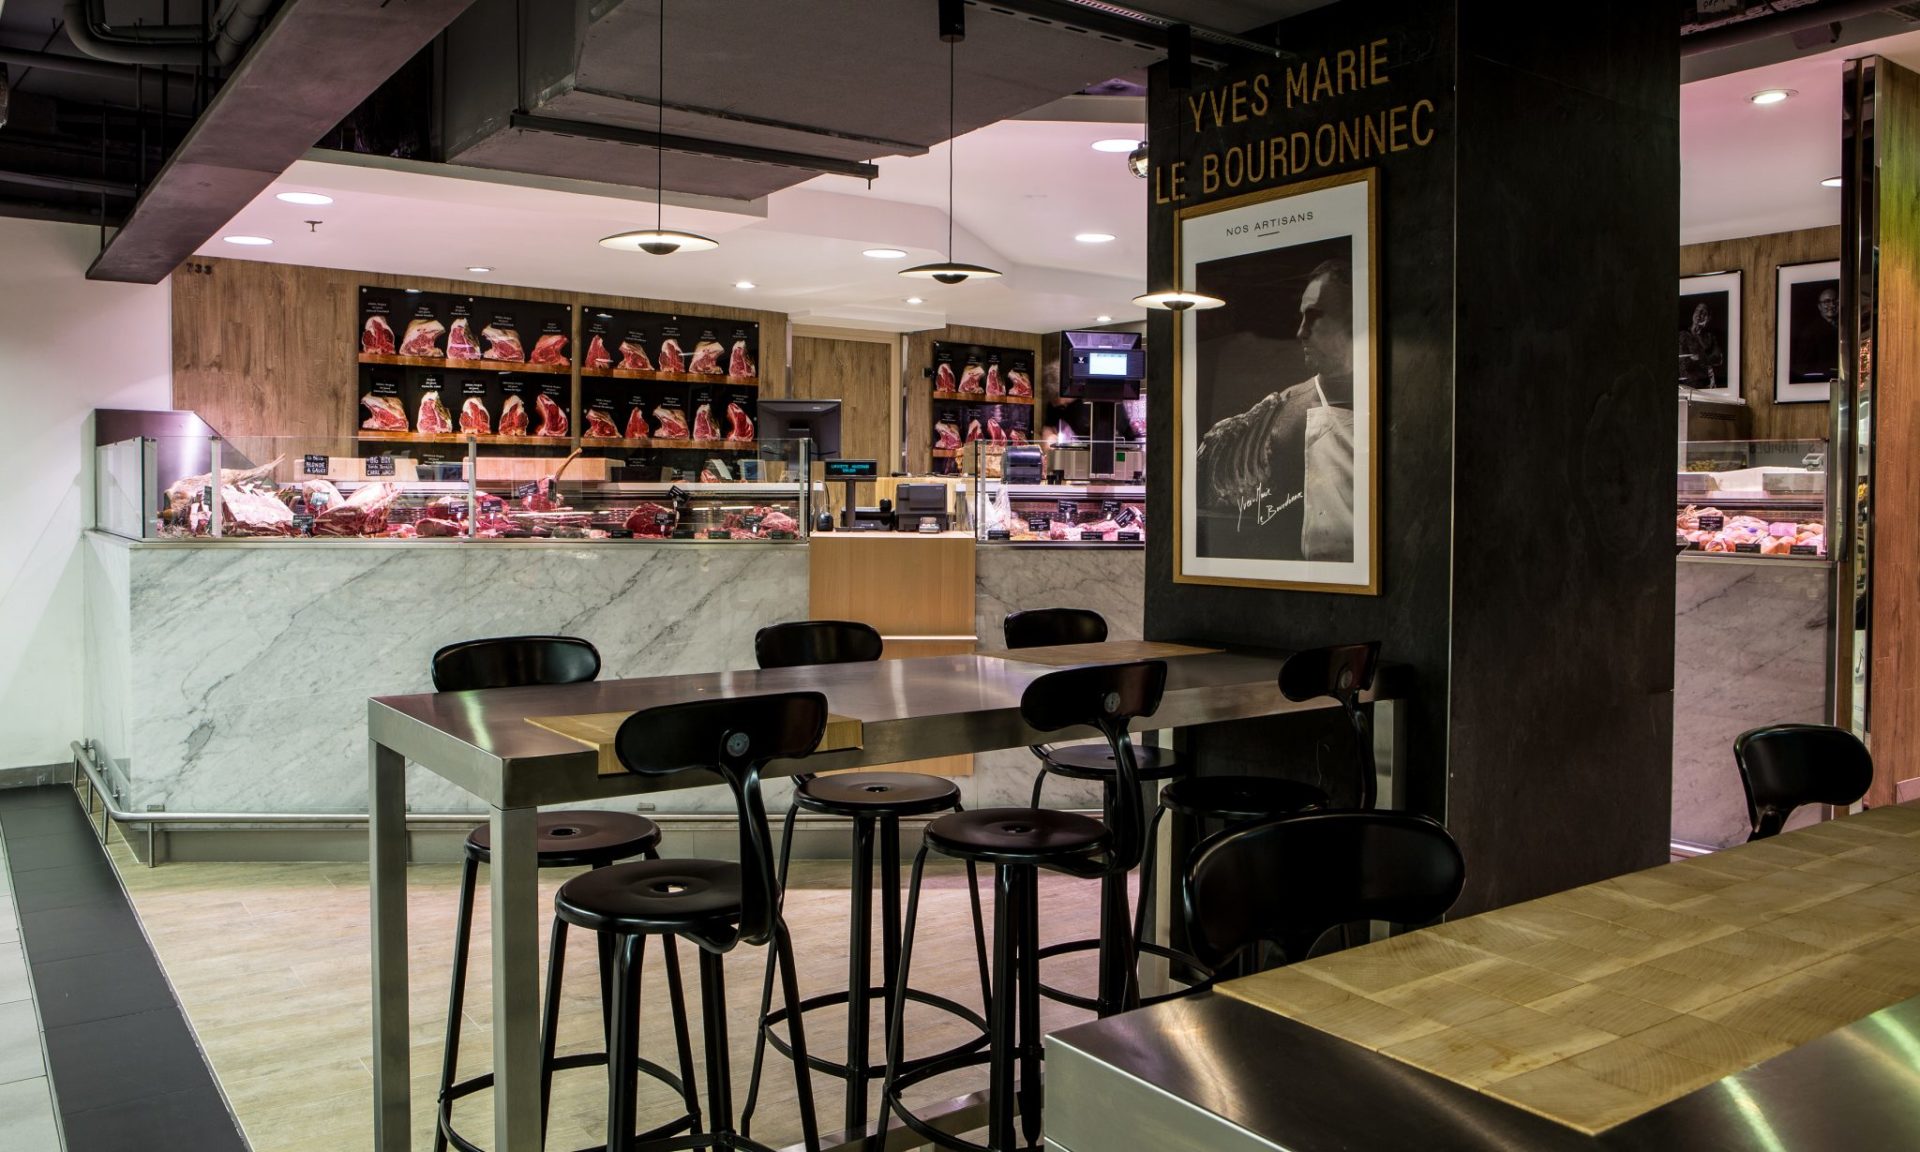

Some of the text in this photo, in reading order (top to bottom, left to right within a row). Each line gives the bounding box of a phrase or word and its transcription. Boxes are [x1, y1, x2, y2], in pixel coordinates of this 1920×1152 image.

[1188, 38, 1389, 133] YVES MARIE
[1156, 99, 1435, 204] LE BOURDONNEC
[1226, 211, 1314, 237] NOS ARTISANS
